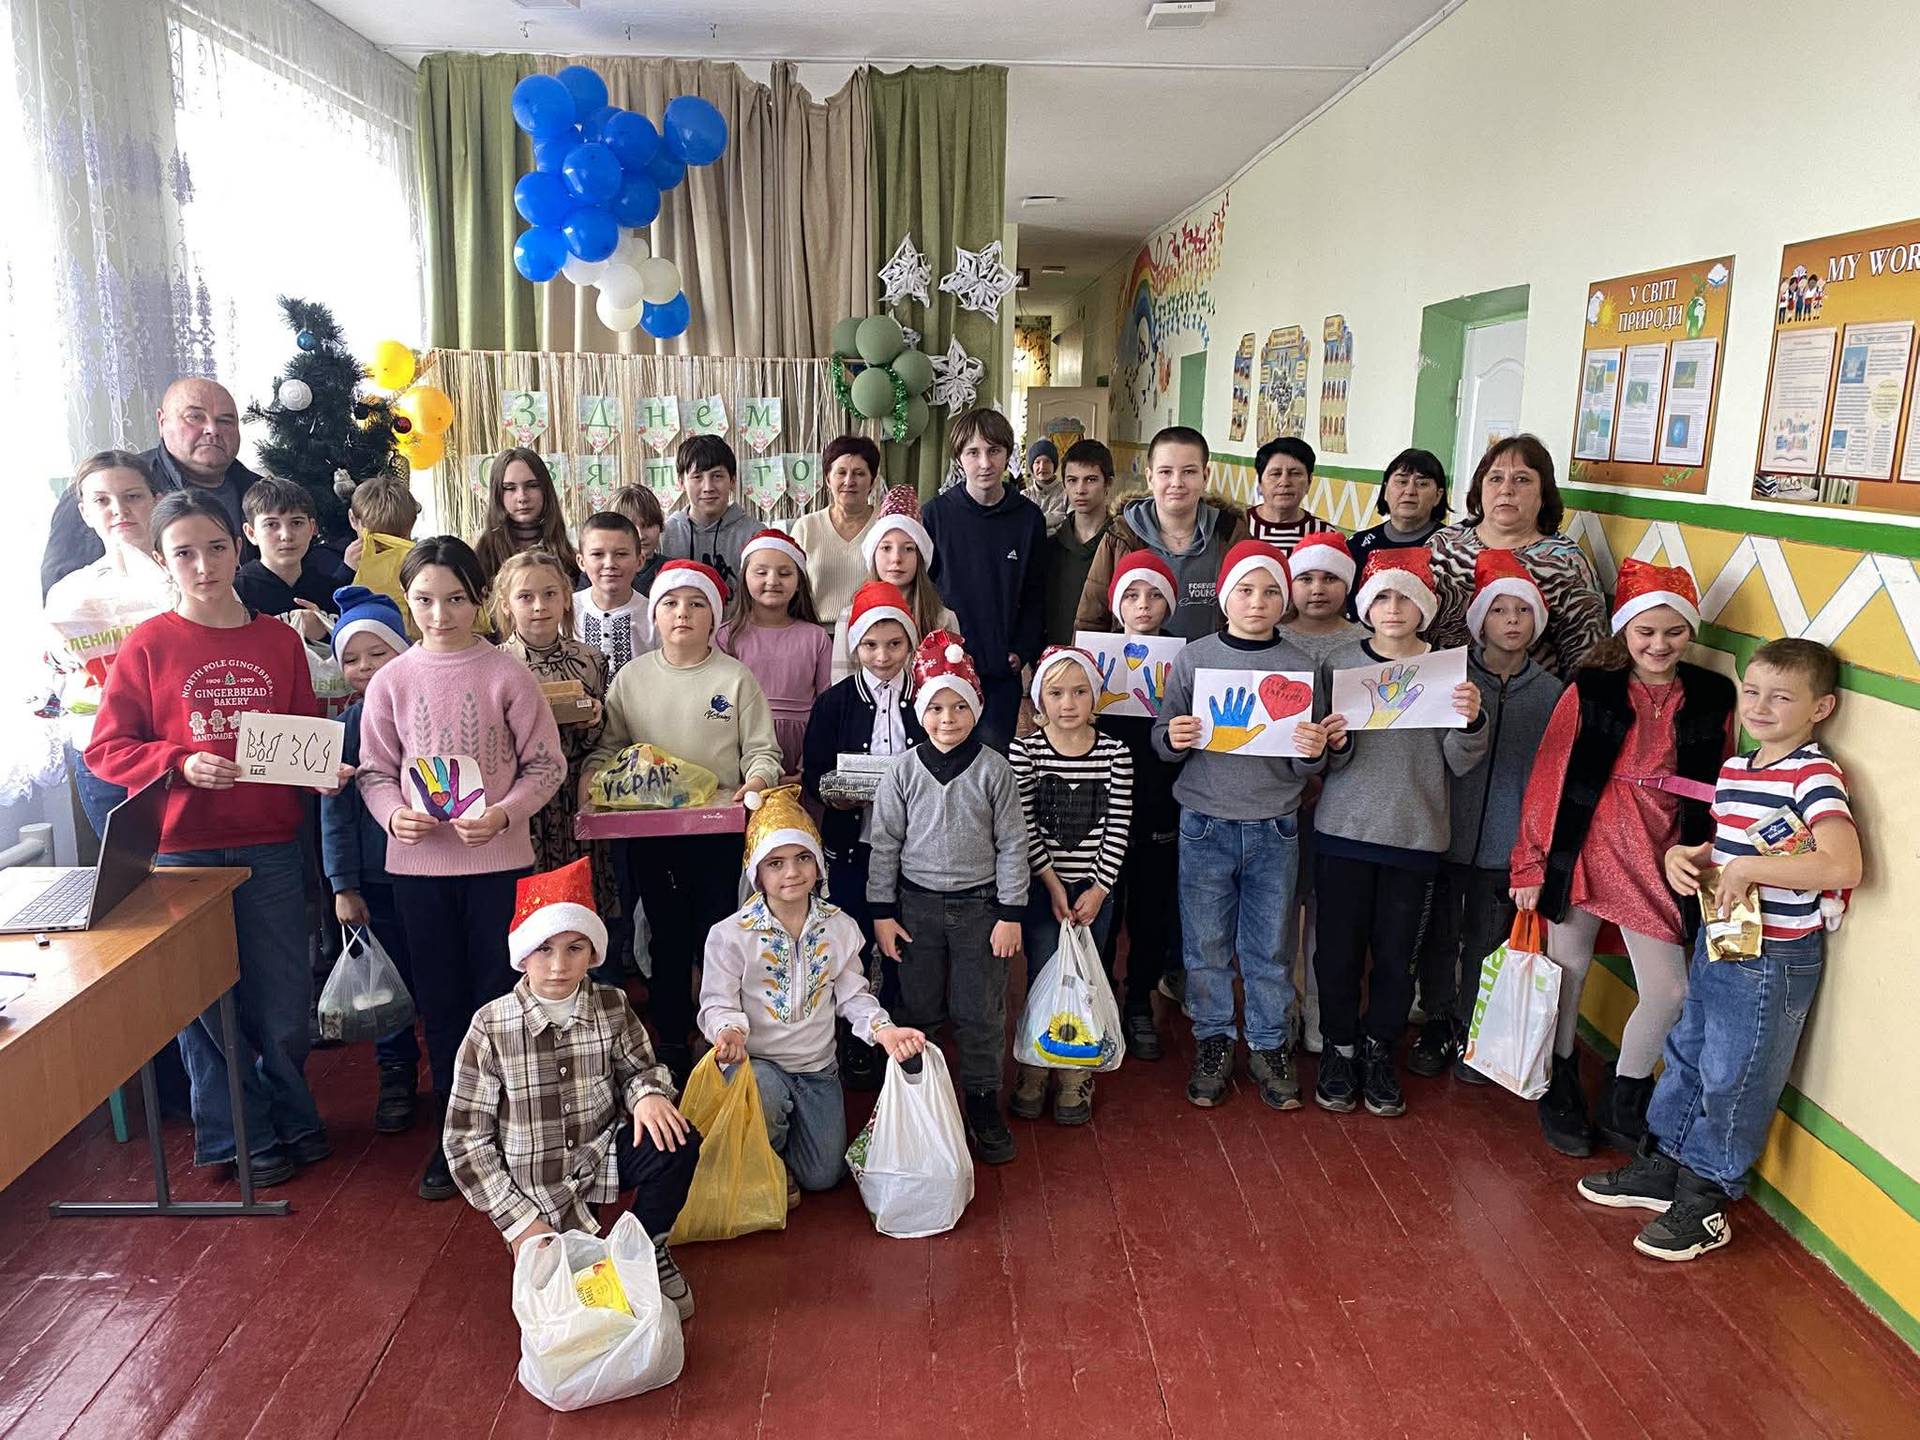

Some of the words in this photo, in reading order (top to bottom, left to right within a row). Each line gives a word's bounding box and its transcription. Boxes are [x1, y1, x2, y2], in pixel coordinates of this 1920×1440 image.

[1826, 252, 1862, 283] MY
[1629, 285, 1639, 306] У
[1642, 278, 1679, 304] СВІТІ
[1617, 304, 1684, 332] ПРИРОДИ
[513, 392, 537, 428] З
[68, 625, 123, 651] ЛЕНИЙ
[181, 668, 204, 698] NORTH
[203, 659, 227, 673] POLE
[194, 687, 267, 699] GINGERBREAD
[213, 697, 249, 706] BAKERY
[192, 732, 234, 743] HANDMADE
